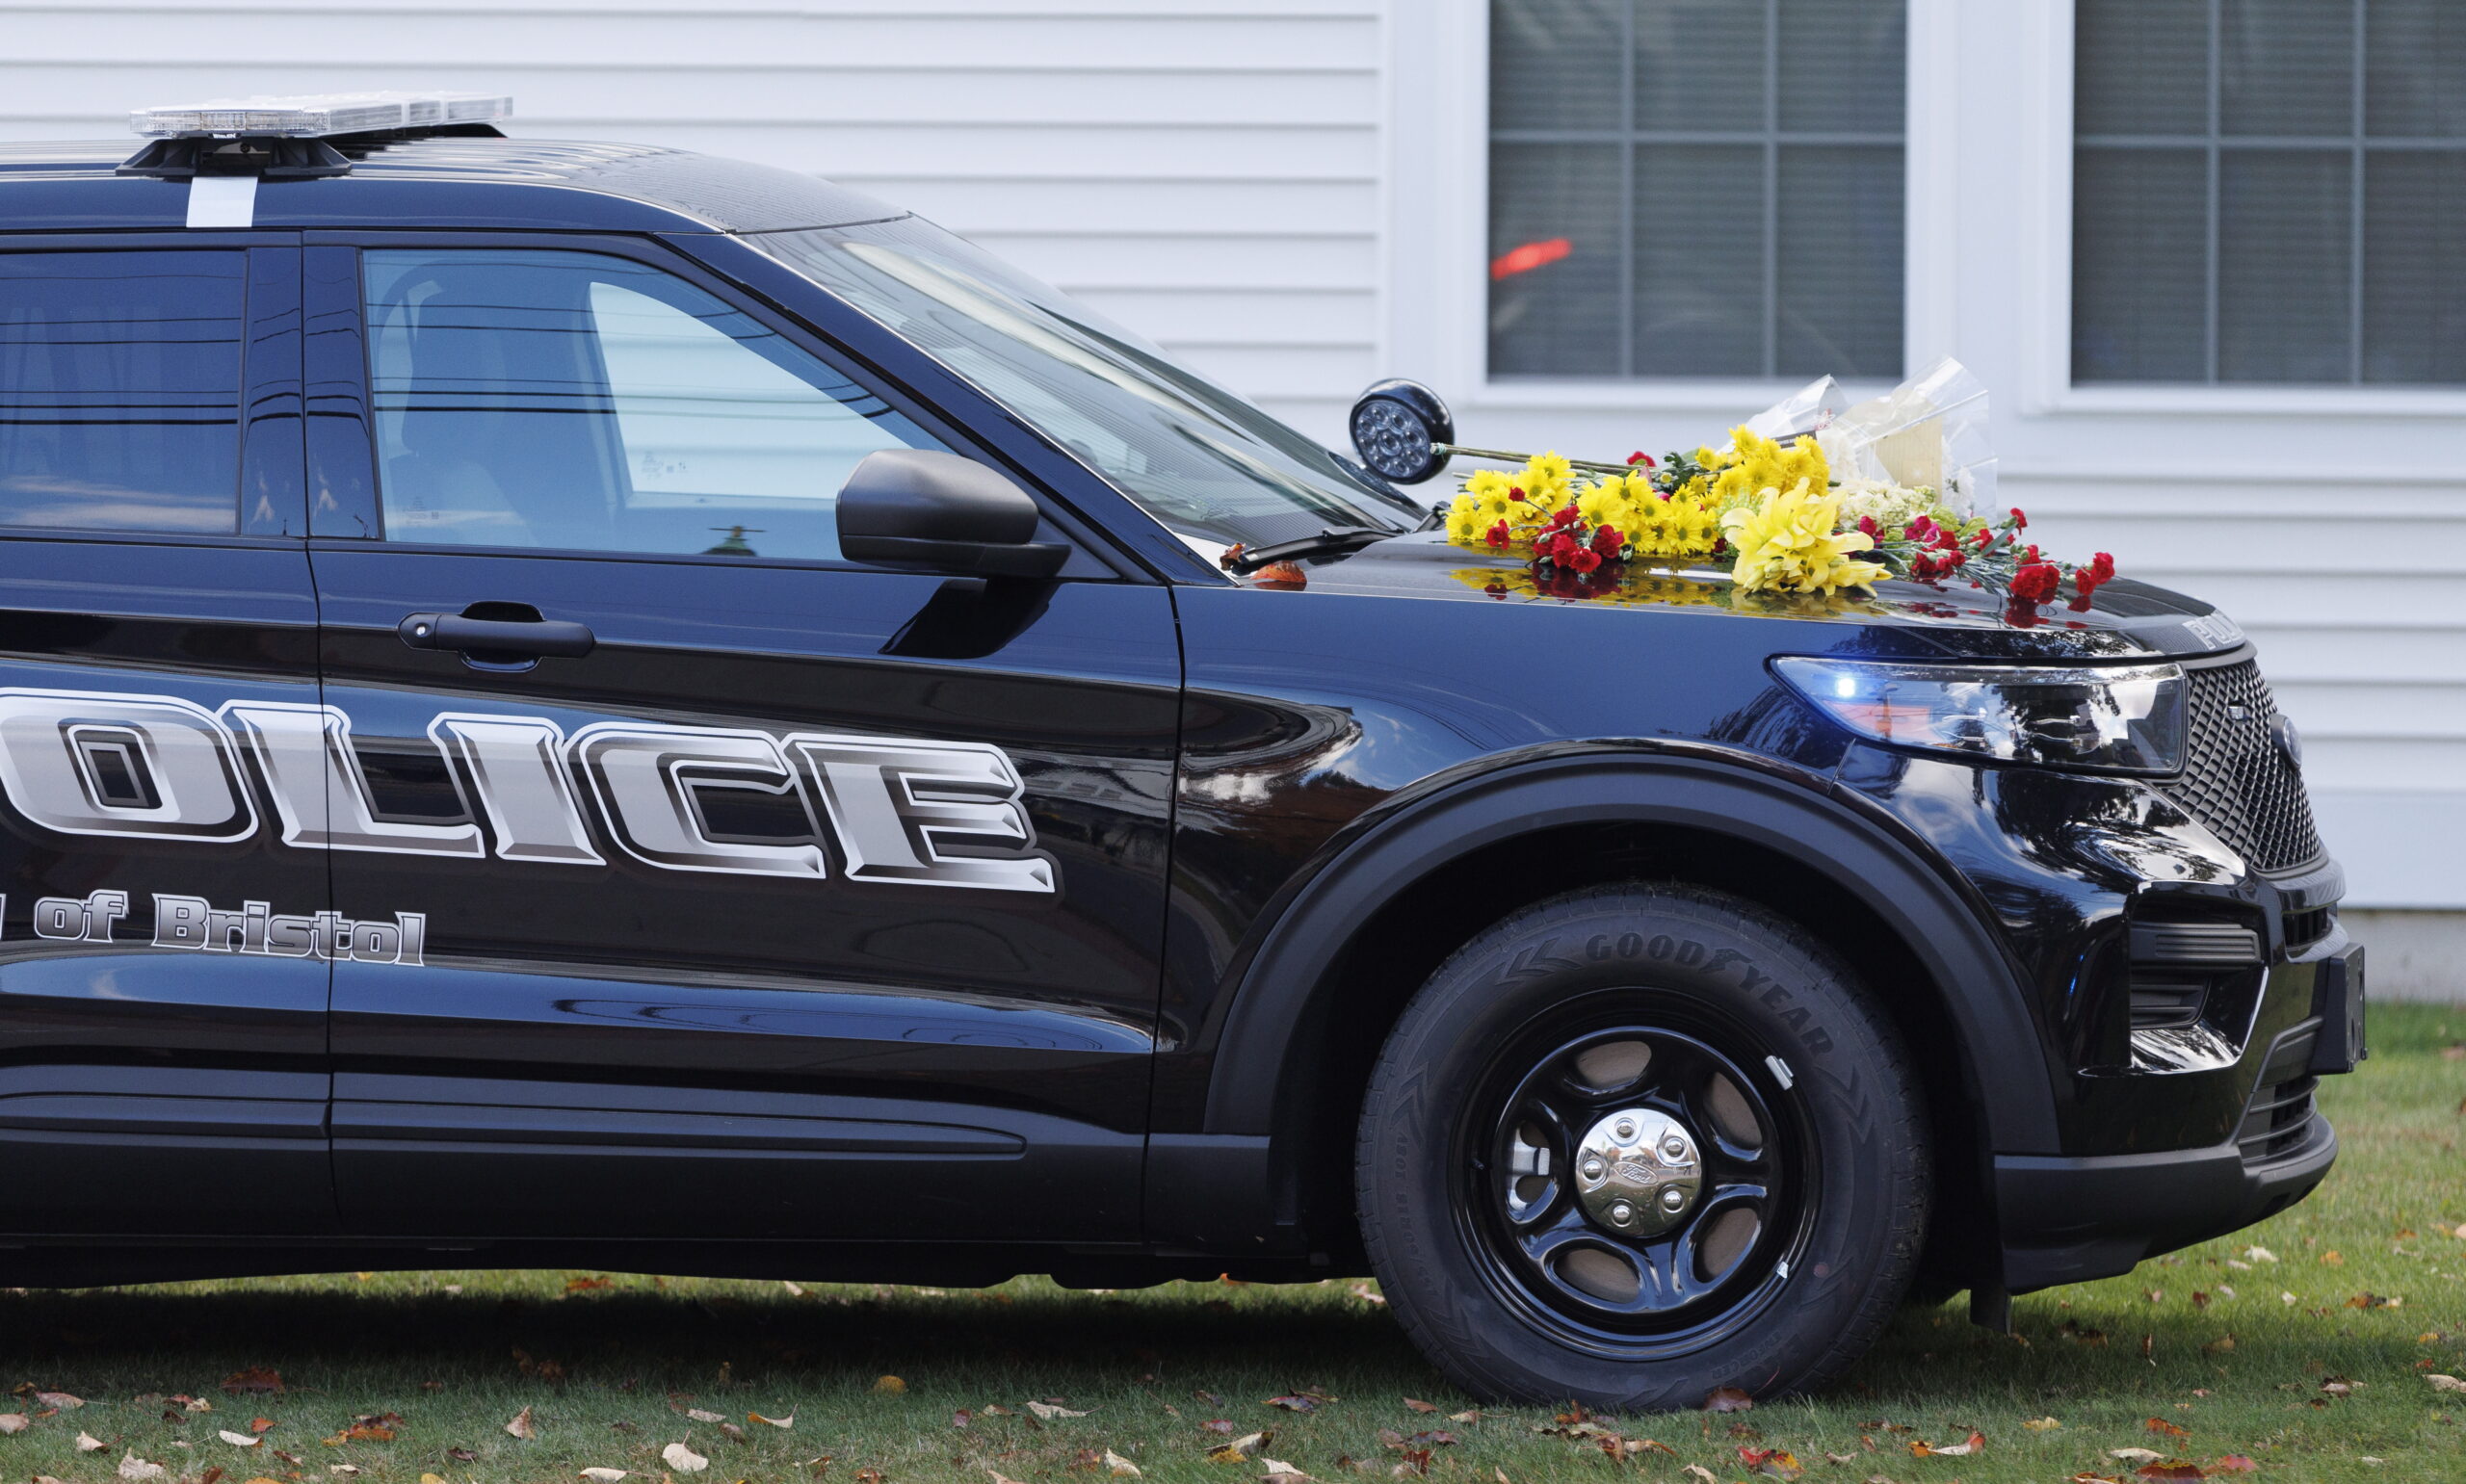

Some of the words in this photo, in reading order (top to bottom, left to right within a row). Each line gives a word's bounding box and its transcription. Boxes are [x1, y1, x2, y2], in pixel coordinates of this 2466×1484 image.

[34, 889, 129, 943] of
[152, 893, 426, 967] Bristol
[1620, 1163, 1652, 1185] Ford
